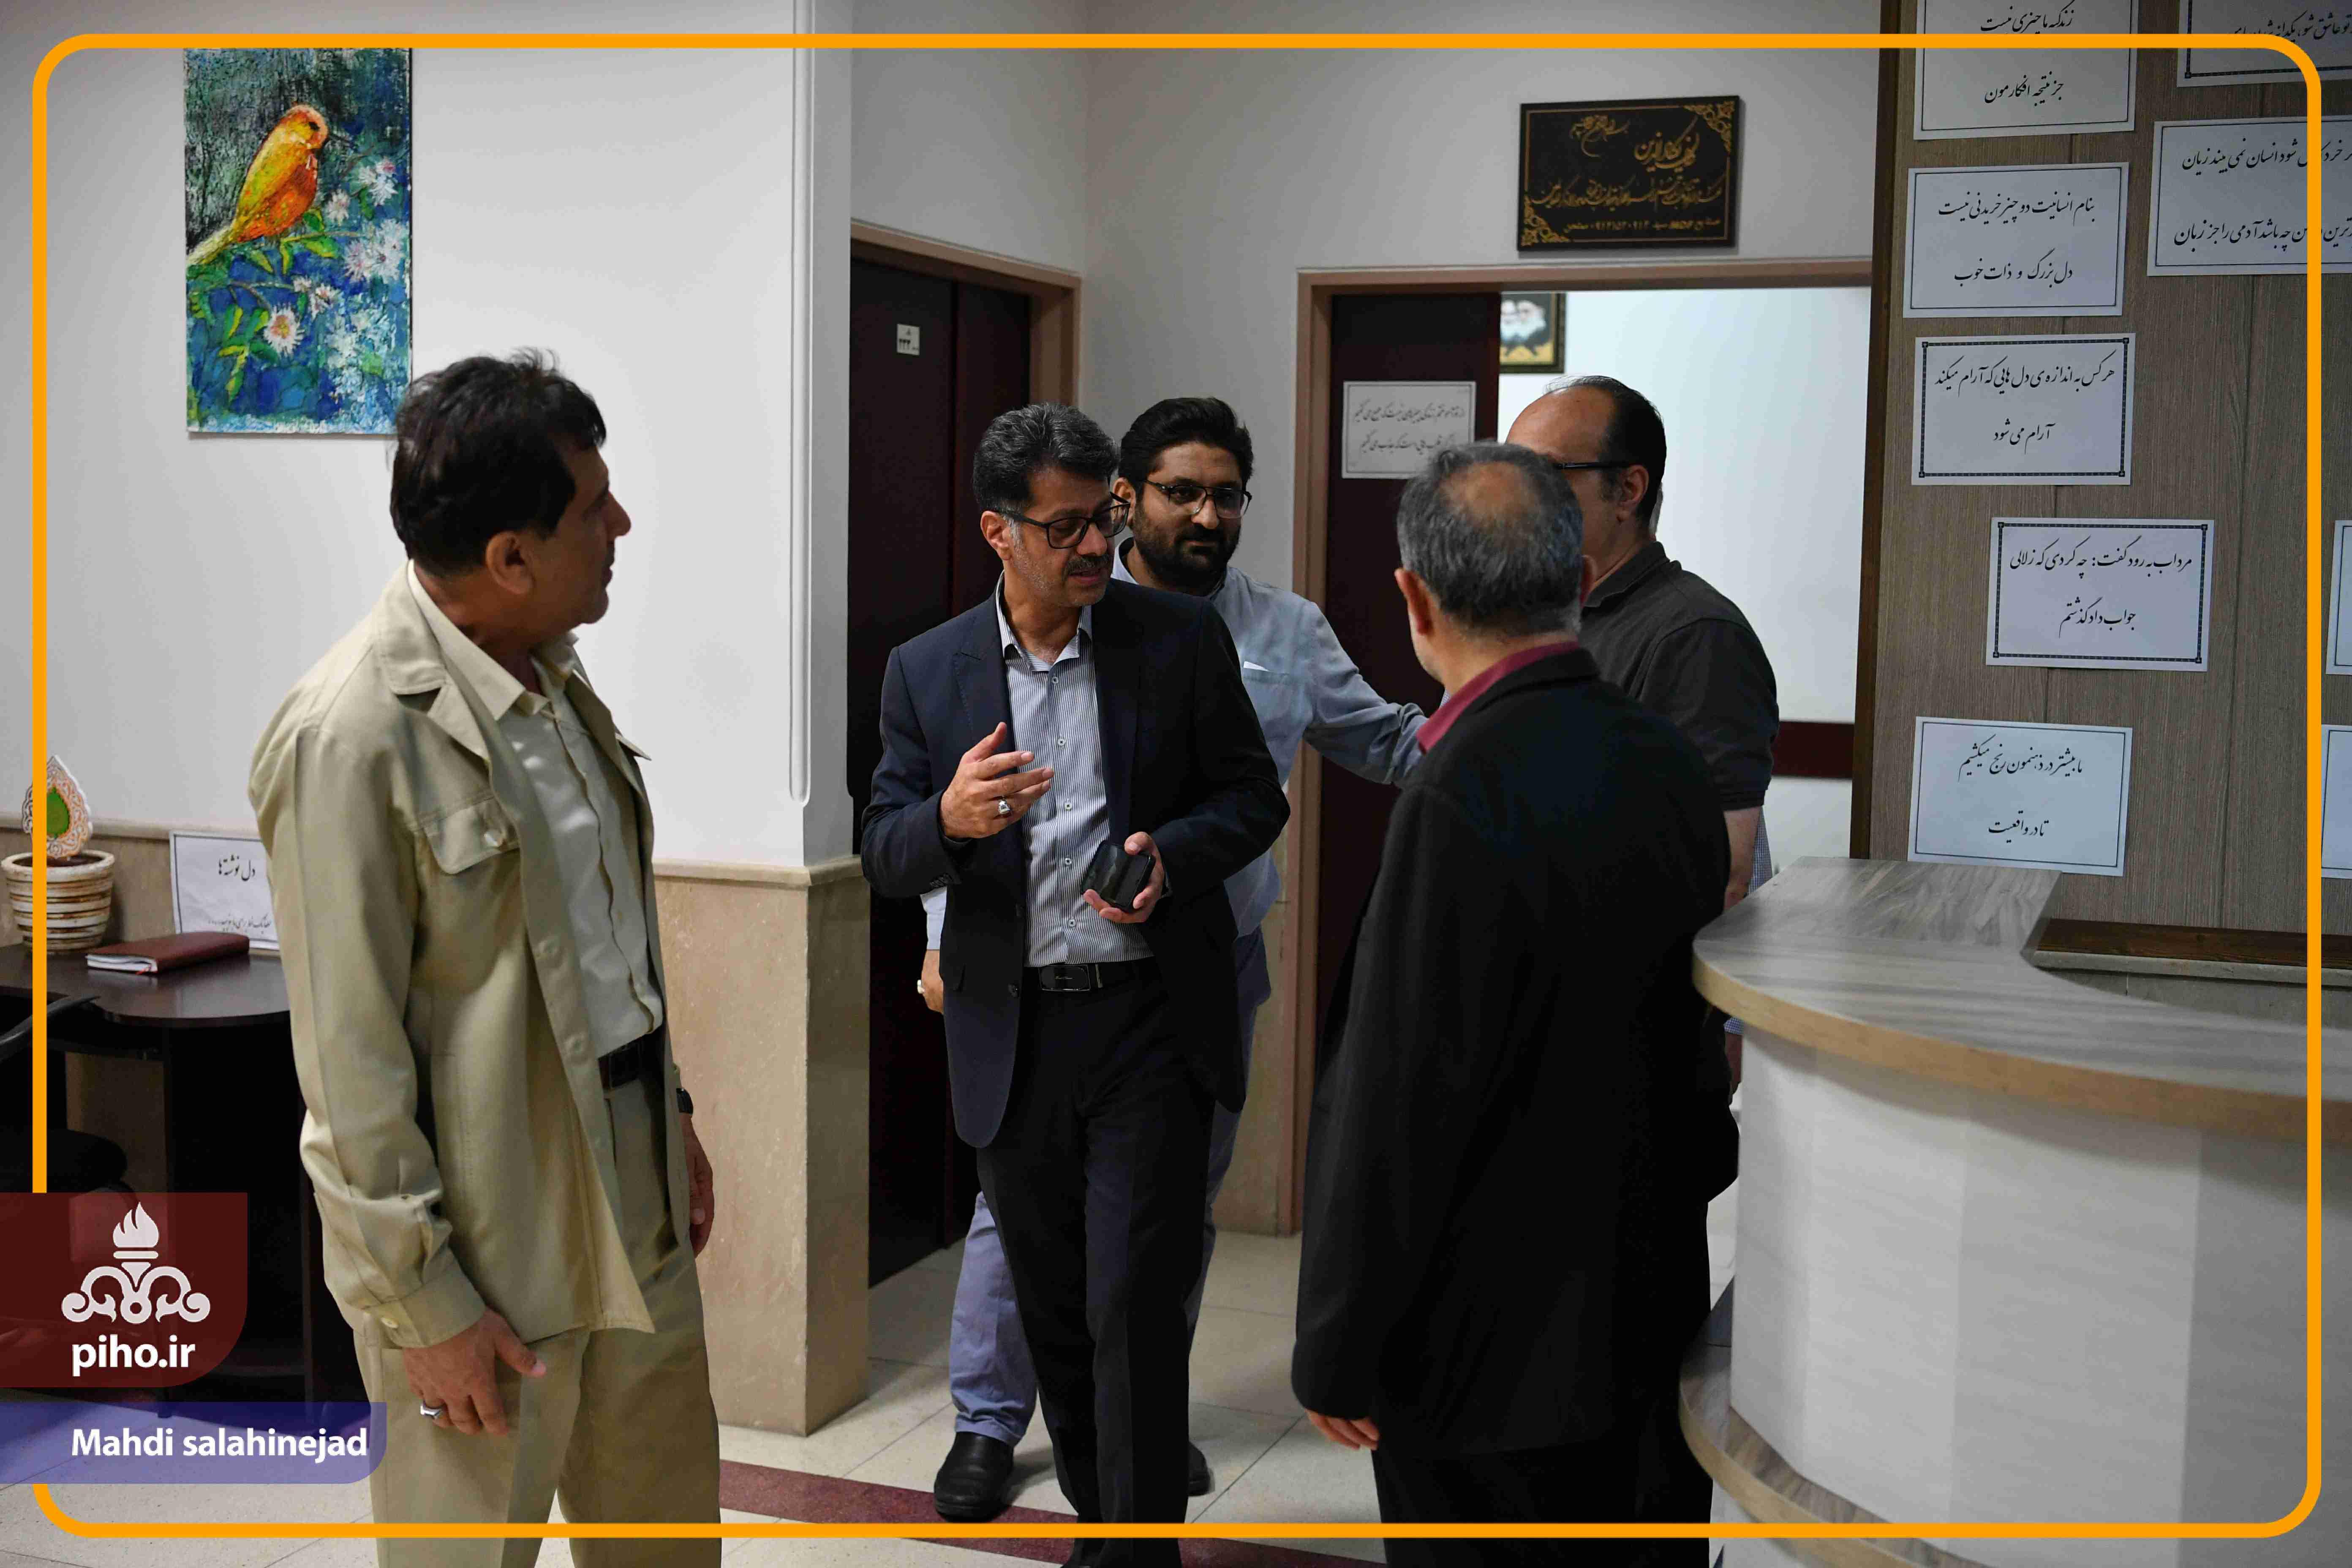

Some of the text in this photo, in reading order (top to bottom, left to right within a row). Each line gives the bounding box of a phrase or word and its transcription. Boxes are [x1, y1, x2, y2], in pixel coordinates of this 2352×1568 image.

[2043, 14, 2048, 28] ما
[2032, 71, 2052, 106] نتیجه
[2051, 80, 2064, 101] جز
[2182, 148, 2210, 175] زیان
[2246, 142, 2278, 168] انسان
[2279, 139, 2298, 163] شود
[1938, 191, 2095, 227] بنام انسانیت دو چیز خریدنی نیست
[2174, 219, 2207, 252] زبان
[2207, 223, 2219, 245] جز
[2221, 223, 2230, 239] را
[2230, 220, 2264, 243] آدمی
[2257, 218, 2278, 249] باشد
[2279, 229, 2291, 252] چه
[1954, 248, 2073, 288] دل بزرگ و ذات خوب
[1957, 366, 1989, 398] آرام
[1984, 356, 2008, 384] که
[2011, 365, 2030, 388] دل
[2074, 377, 2080, 392] به
[2024, 423, 2056, 455] آرام
[2010, 549, 2036, 569] زلالی
[2035, 537, 2060, 566] که
[2044, 534, 2091, 570] کردی
[2128, 558, 2145, 567] رود
[2153, 553, 2192, 574] مرداب
[2076, 558, 2088, 579] چه
[2145, 562, 2153, 577] به
[2058, 596, 2136, 639] جواب داد گذشتم
[1989, 743, 2007, 775] رنج
[2006, 746, 2043, 774] ذهنمون
[2044, 762, 2053, 771] در
[2049, 747, 2076, 777] بیشتر
[2077, 760, 2082, 773] ما
[1988, 810, 2050, 844] تا در واقعیت
